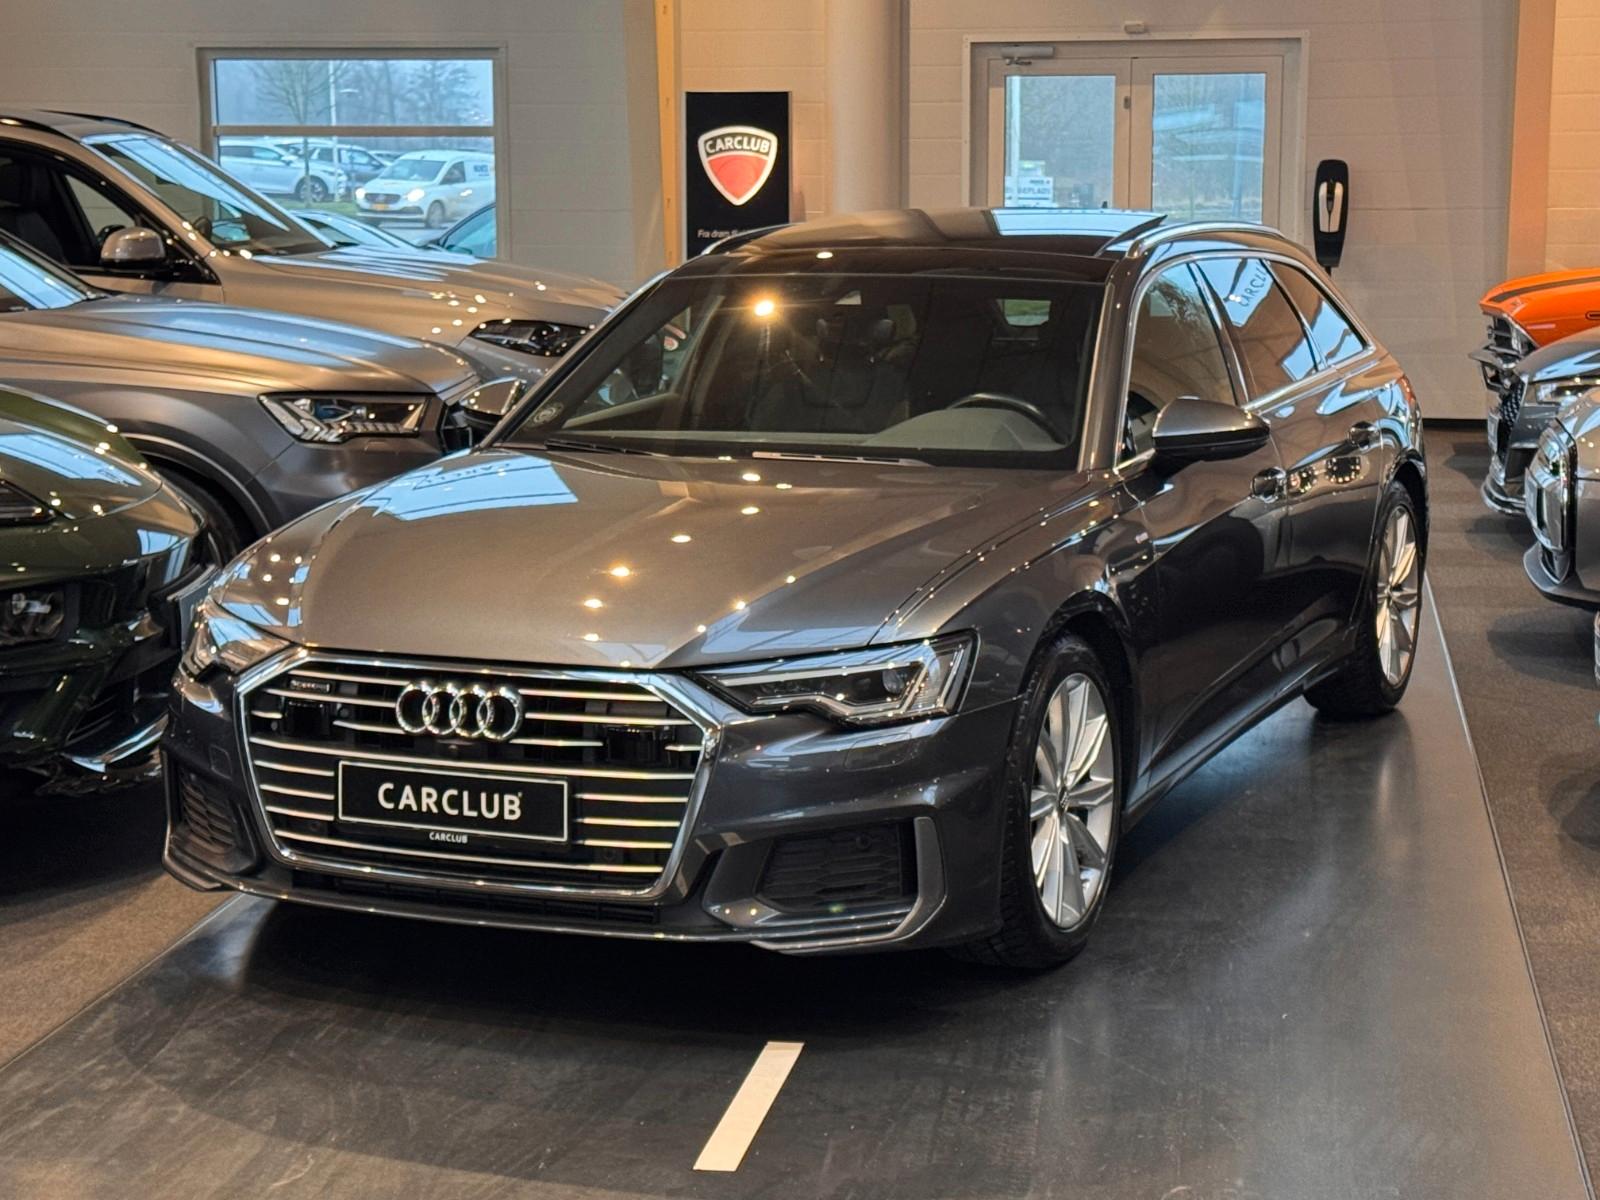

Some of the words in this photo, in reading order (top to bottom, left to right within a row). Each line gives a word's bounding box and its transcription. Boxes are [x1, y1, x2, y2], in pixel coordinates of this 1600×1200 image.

[705, 136, 770, 153] CARCLUB
[377, 782, 521, 821] CARCLUB
[428, 831, 468, 844] CARCLUB
